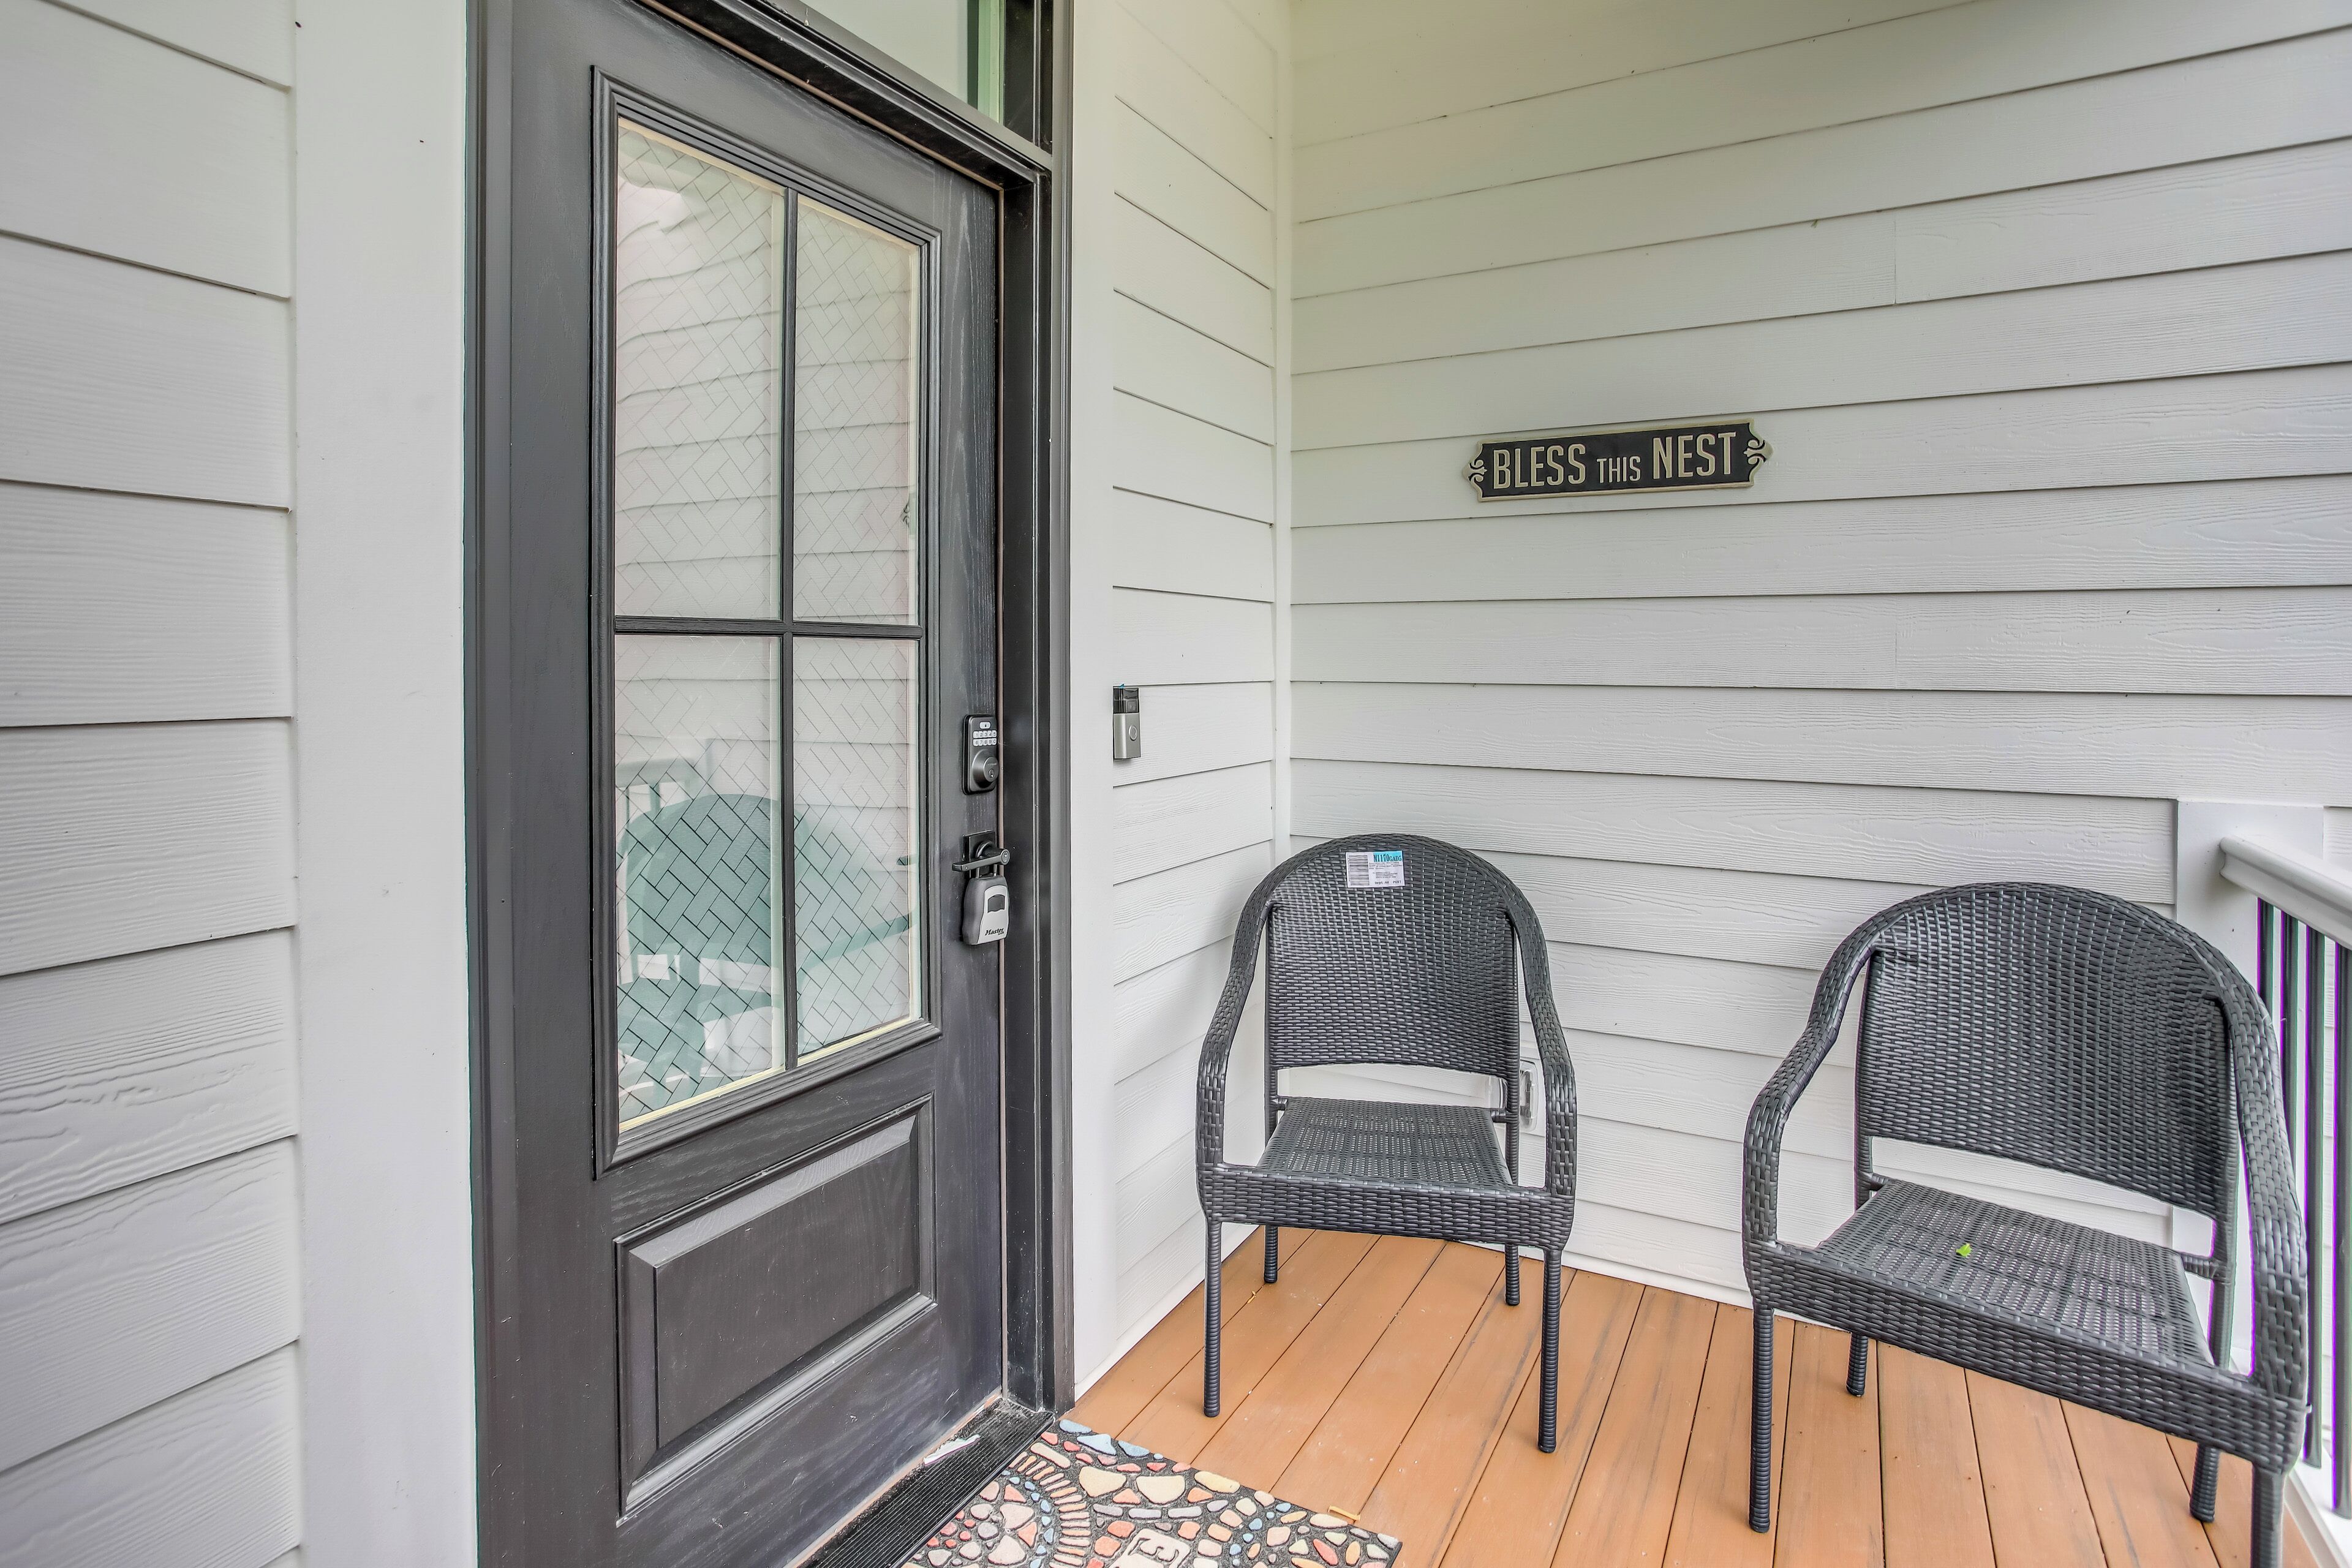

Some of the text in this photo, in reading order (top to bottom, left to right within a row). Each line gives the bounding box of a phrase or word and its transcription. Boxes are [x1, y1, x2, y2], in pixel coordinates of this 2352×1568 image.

[1493, 432, 1736, 489] BLESS THIS NEST
[985, 927, 1004, 936] Master
